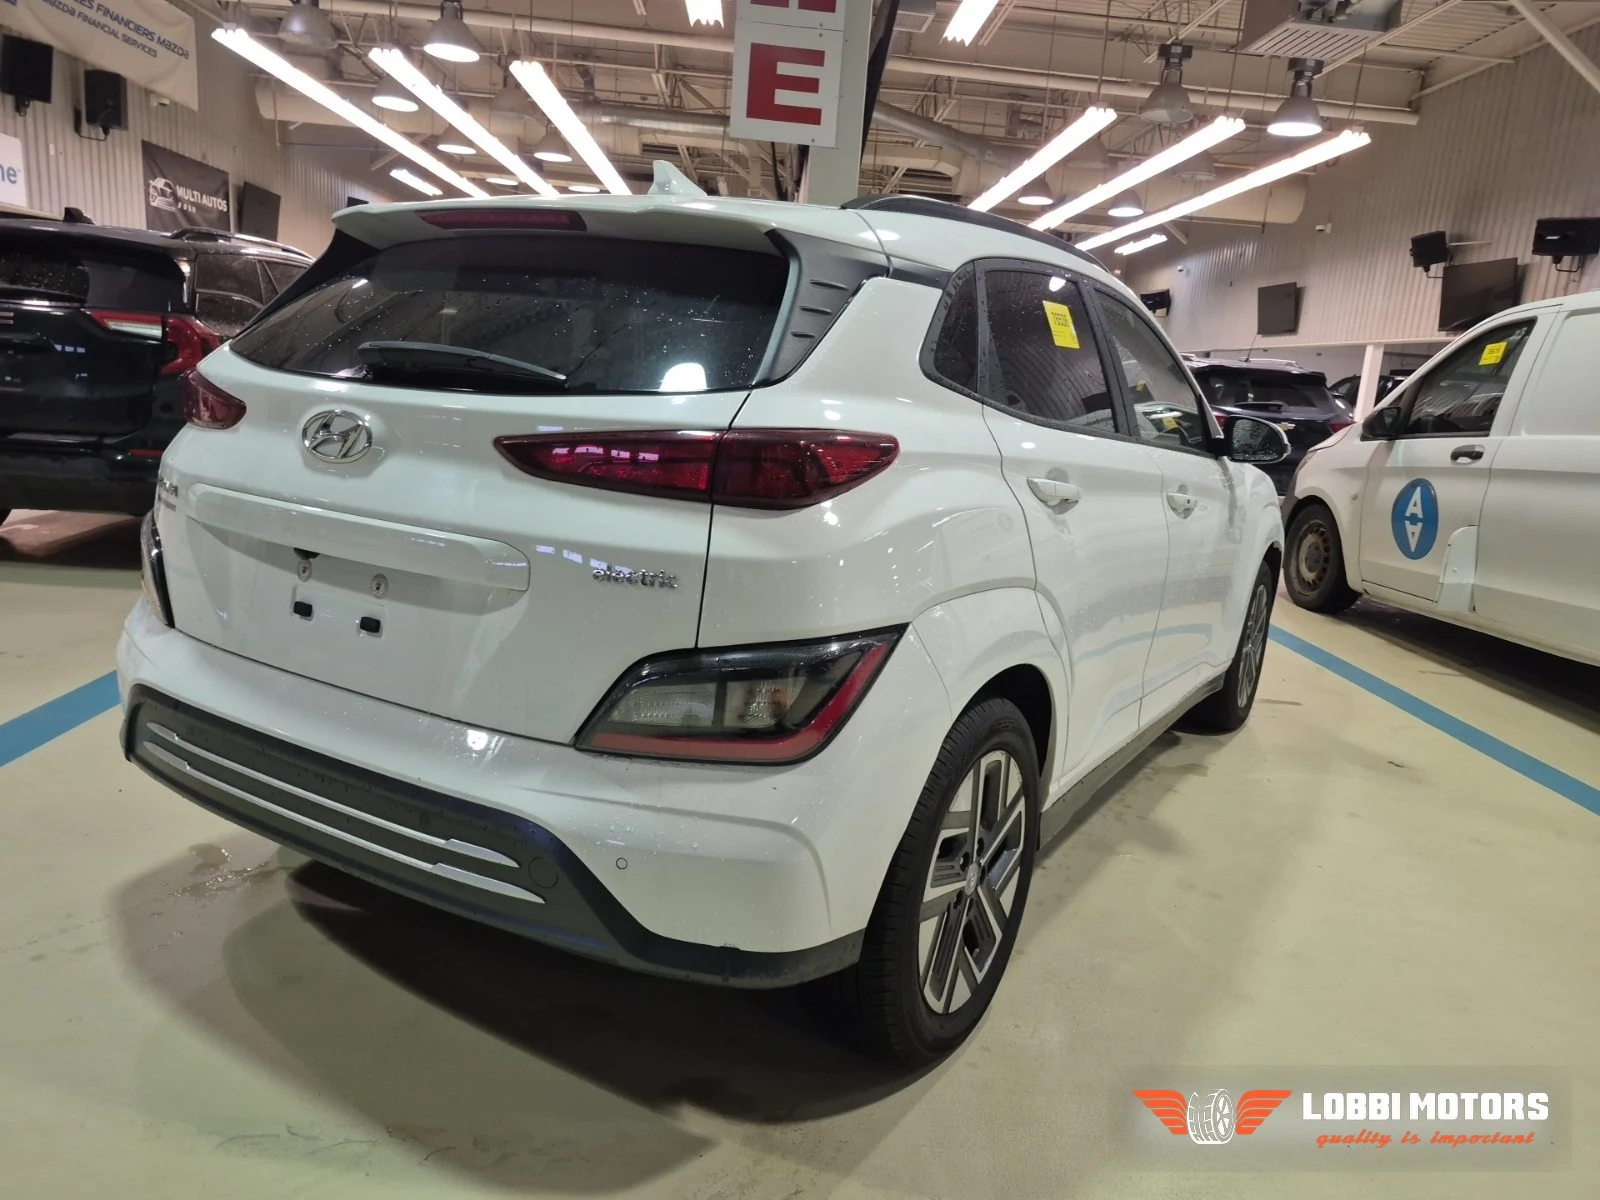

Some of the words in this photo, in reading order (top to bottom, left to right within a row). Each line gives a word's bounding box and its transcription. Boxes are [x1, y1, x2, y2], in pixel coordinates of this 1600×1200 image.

[77, 12, 120, 40] FINANCIAL
[121, 34, 158, 58] SERVICES
[96, 4, 156, 42] FINANCIERS
[746, 42, 825, 126] E
[176, 185, 202, 203] MULTI
[202, 194, 228, 212] AUTOS
[592, 567, 679, 589] electric
